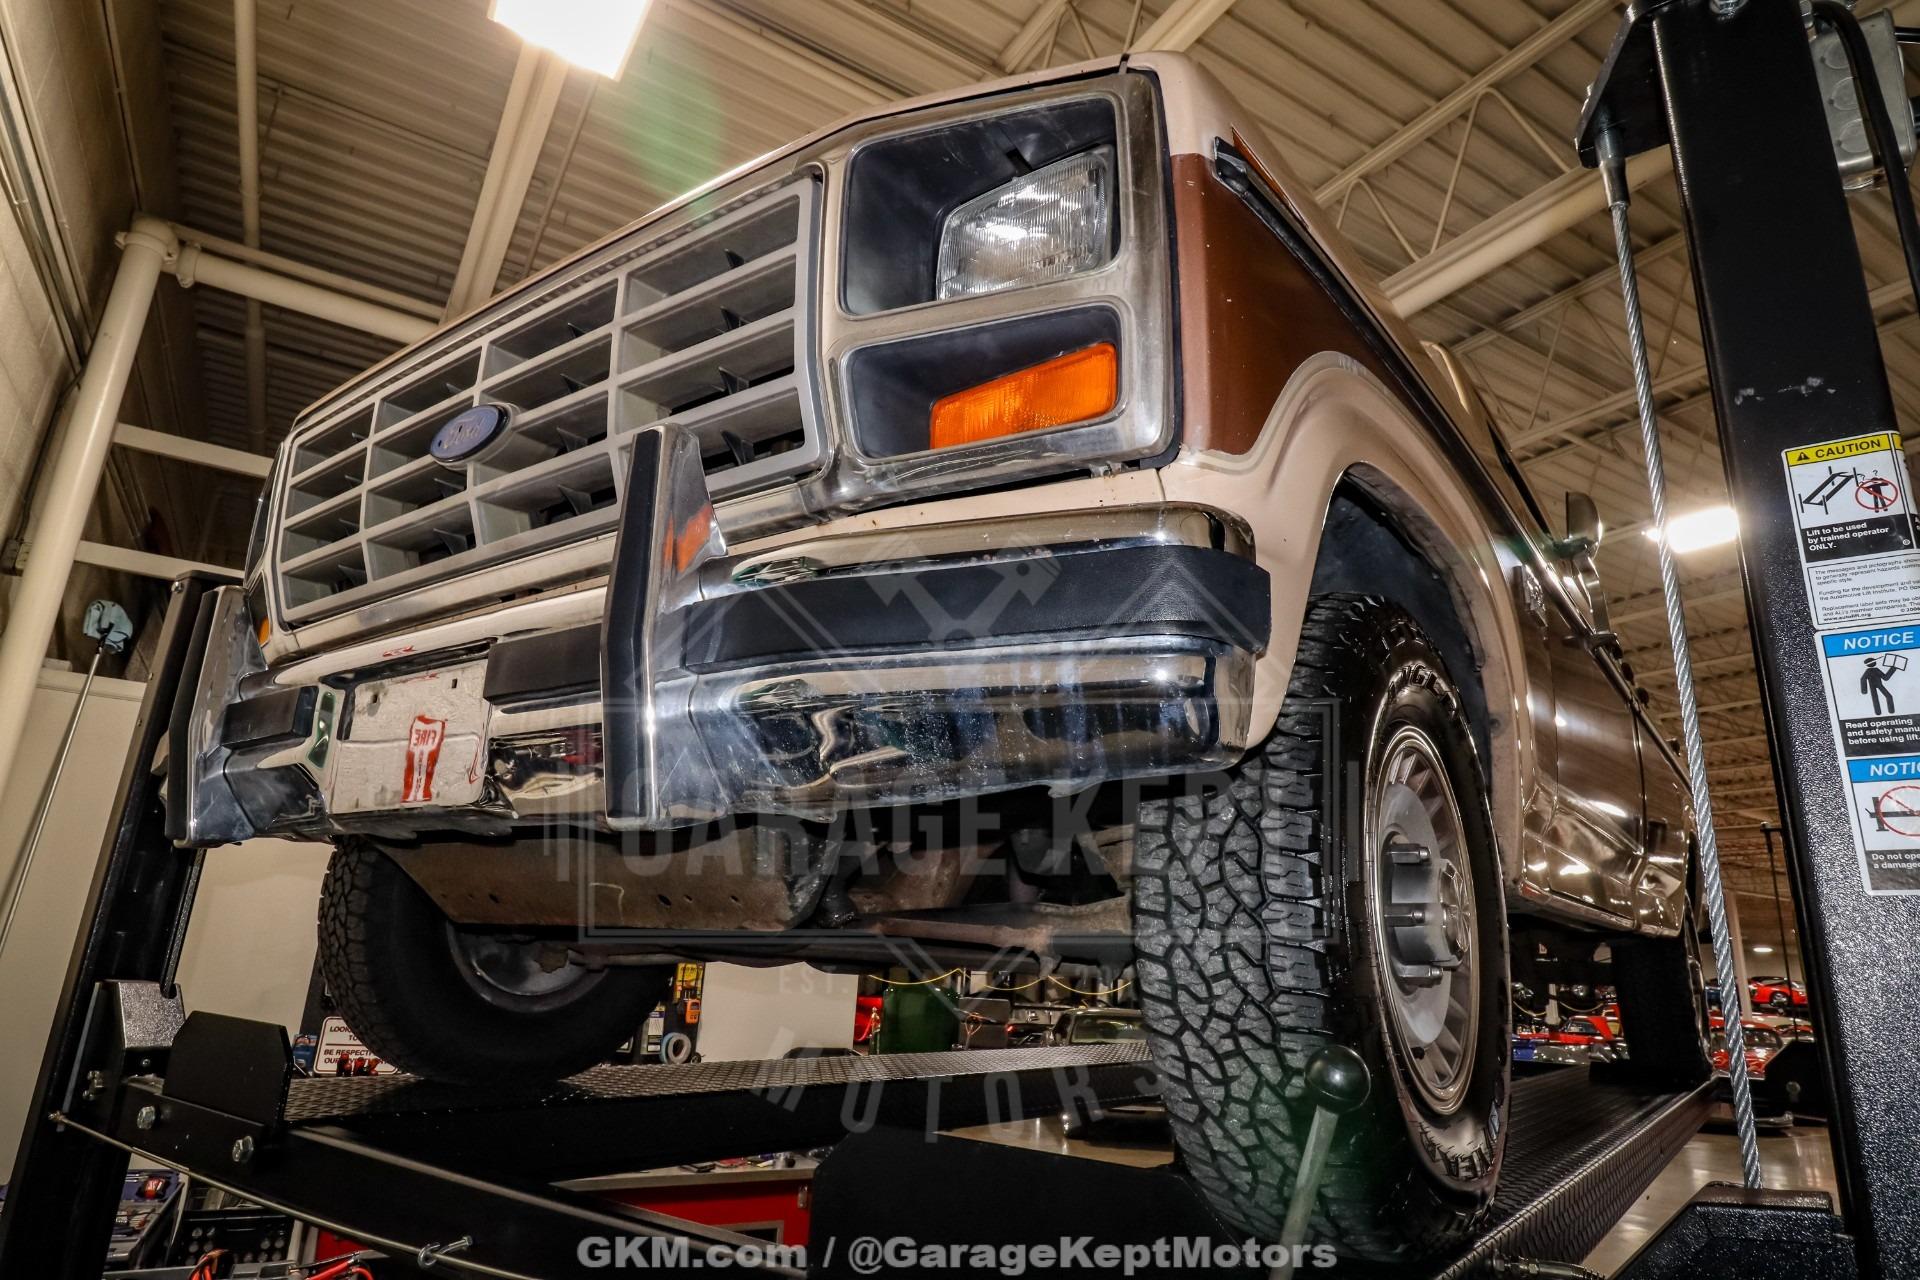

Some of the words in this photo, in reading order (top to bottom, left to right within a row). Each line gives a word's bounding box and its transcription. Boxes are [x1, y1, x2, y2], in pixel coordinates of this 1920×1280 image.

[1815, 440, 1881, 459] CAUTION
[1806, 529, 1820, 537] Lift
[1833, 525, 1844, 533] be
[1846, 522, 1867, 531] used
[1808, 537, 1819, 545] by
[1820, 532, 1850, 543] trained
[1852, 527, 1890, 538] operator
[1809, 542, 1837, 551] ONLY.
[1844, 631, 1915, 651] NOTICE
[1845, 721, 1868, 729] Read
[1870, 718, 1913, 728] operating
[1865, 728, 1893, 736] safety
[1848, 736, 1877, 745] before
[1879, 735, 1905, 743] using
[1870, 761, 1920, 777] NOTI
[1905, 853, 1920, 861] ope
